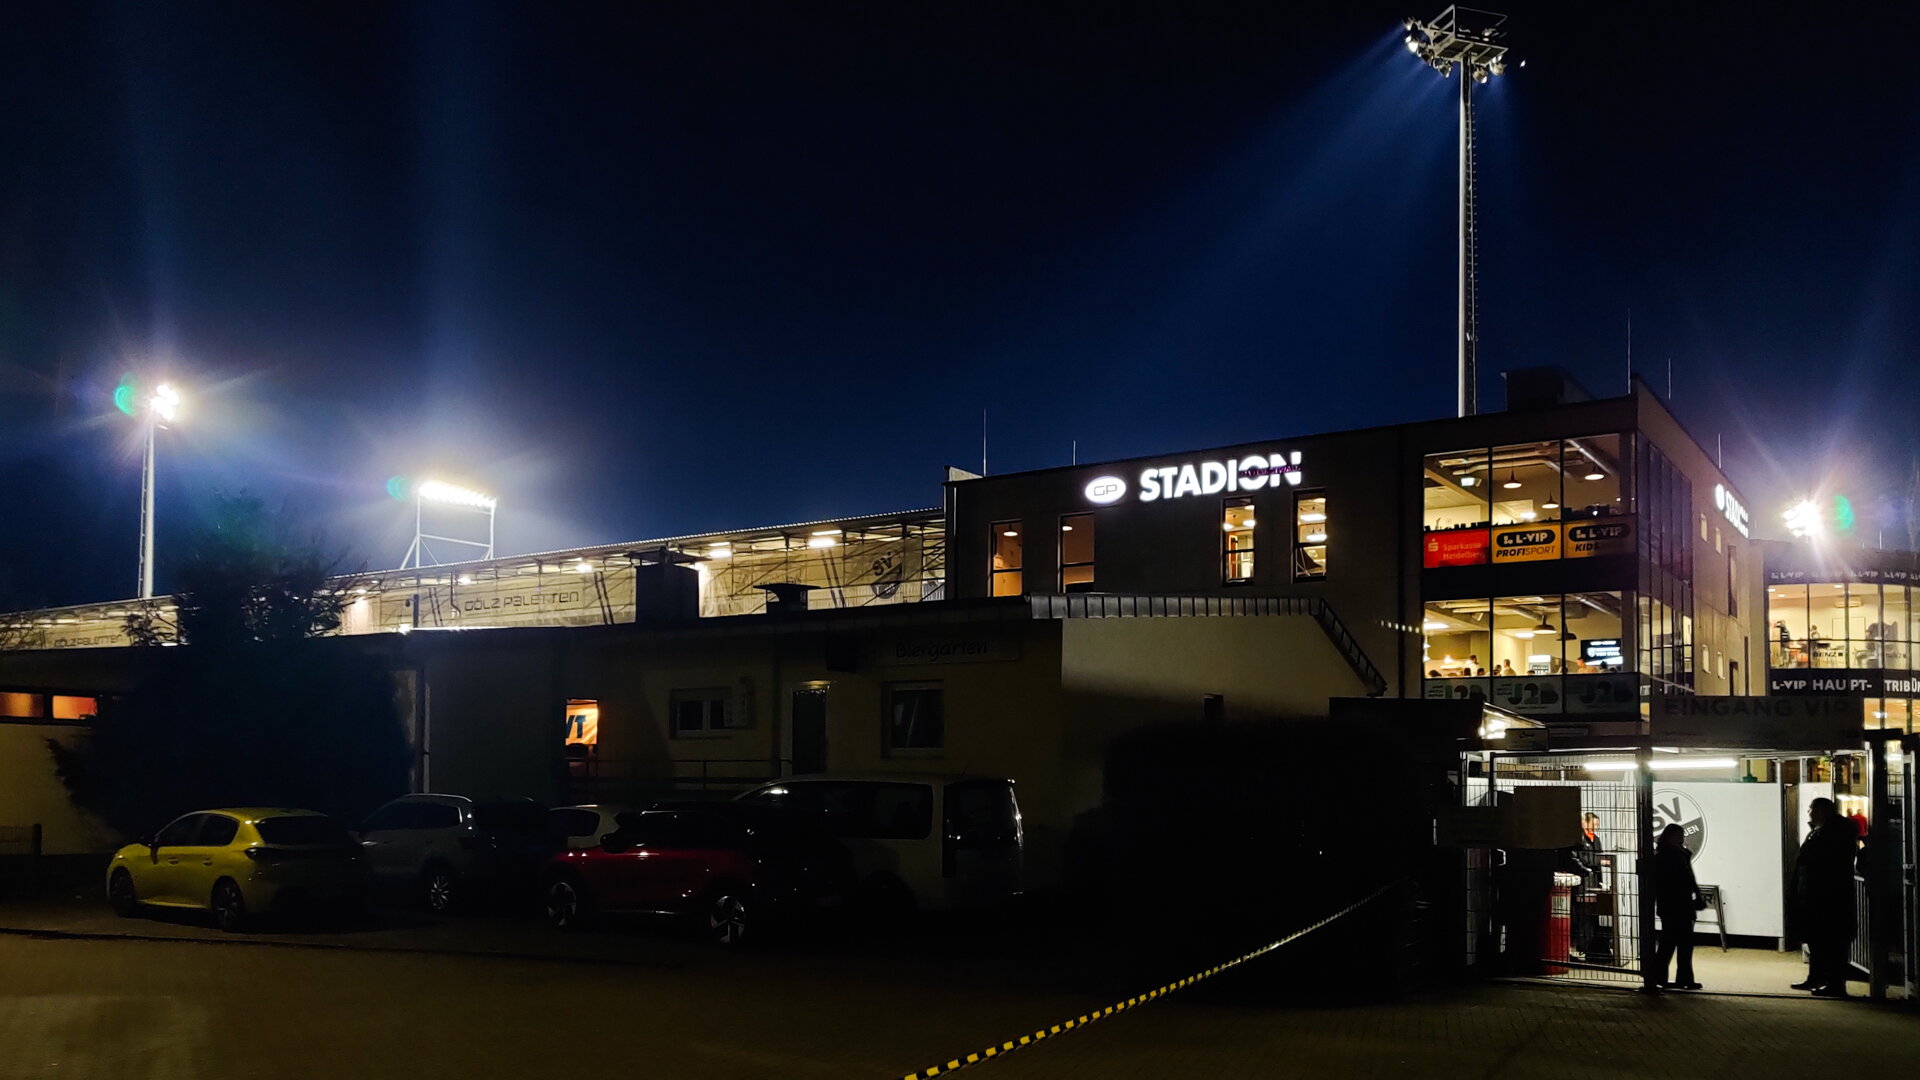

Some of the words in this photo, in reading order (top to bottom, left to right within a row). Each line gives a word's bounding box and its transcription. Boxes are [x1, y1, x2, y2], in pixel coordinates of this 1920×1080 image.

[1139, 451, 1302, 502] STADION
[1094, 484, 1118, 496] GP
[1515, 532, 1548, 544] L-VIP
[1496, 545, 1556, 558] PROFISPORT
[895, 639, 988, 662] Biergarten
[1772, 680, 1807, 691] L-VIP
[1664, 698, 1793, 717] EINGANG
[1804, 698, 1850, 717] VIP
